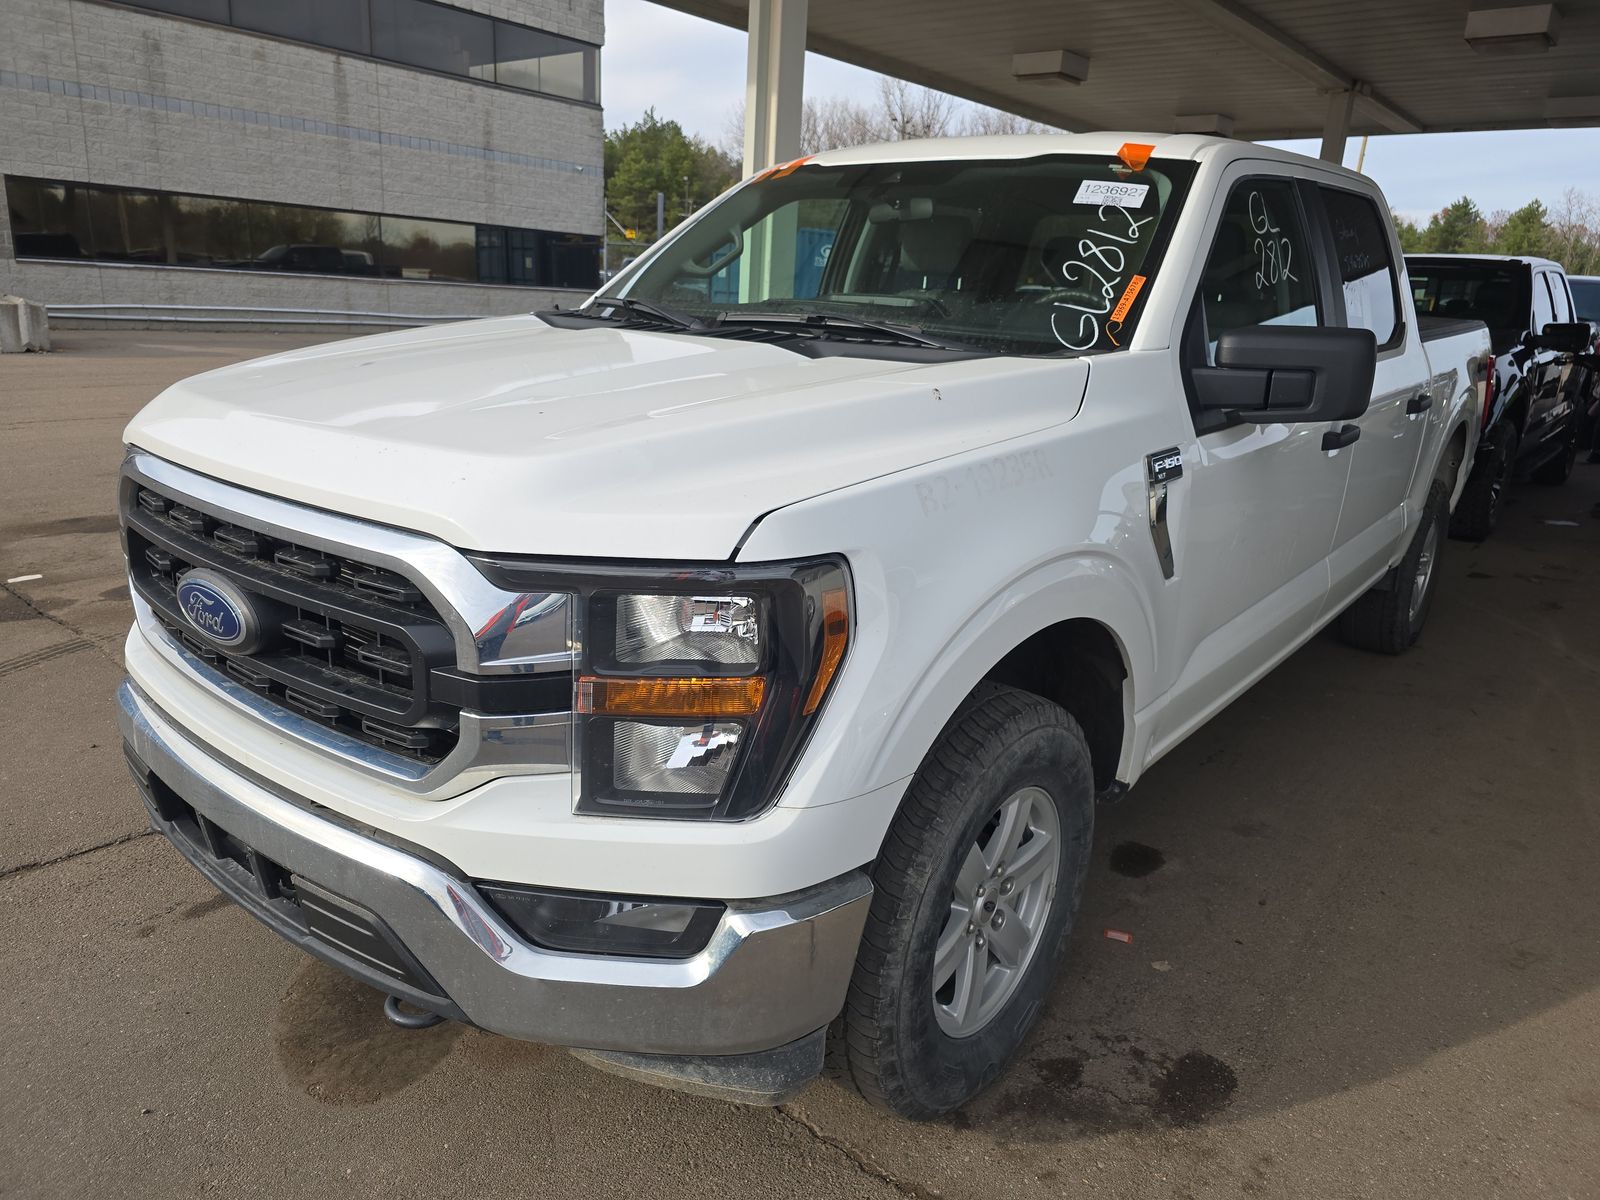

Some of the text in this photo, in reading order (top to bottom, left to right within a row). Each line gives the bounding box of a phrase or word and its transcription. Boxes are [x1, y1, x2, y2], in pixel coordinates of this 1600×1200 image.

[1083, 184, 1147, 198] 1236927
[1254, 237, 1299, 290] 2812
[1154, 455, 1182, 473] F-150
[187, 591, 224, 633] Ford
